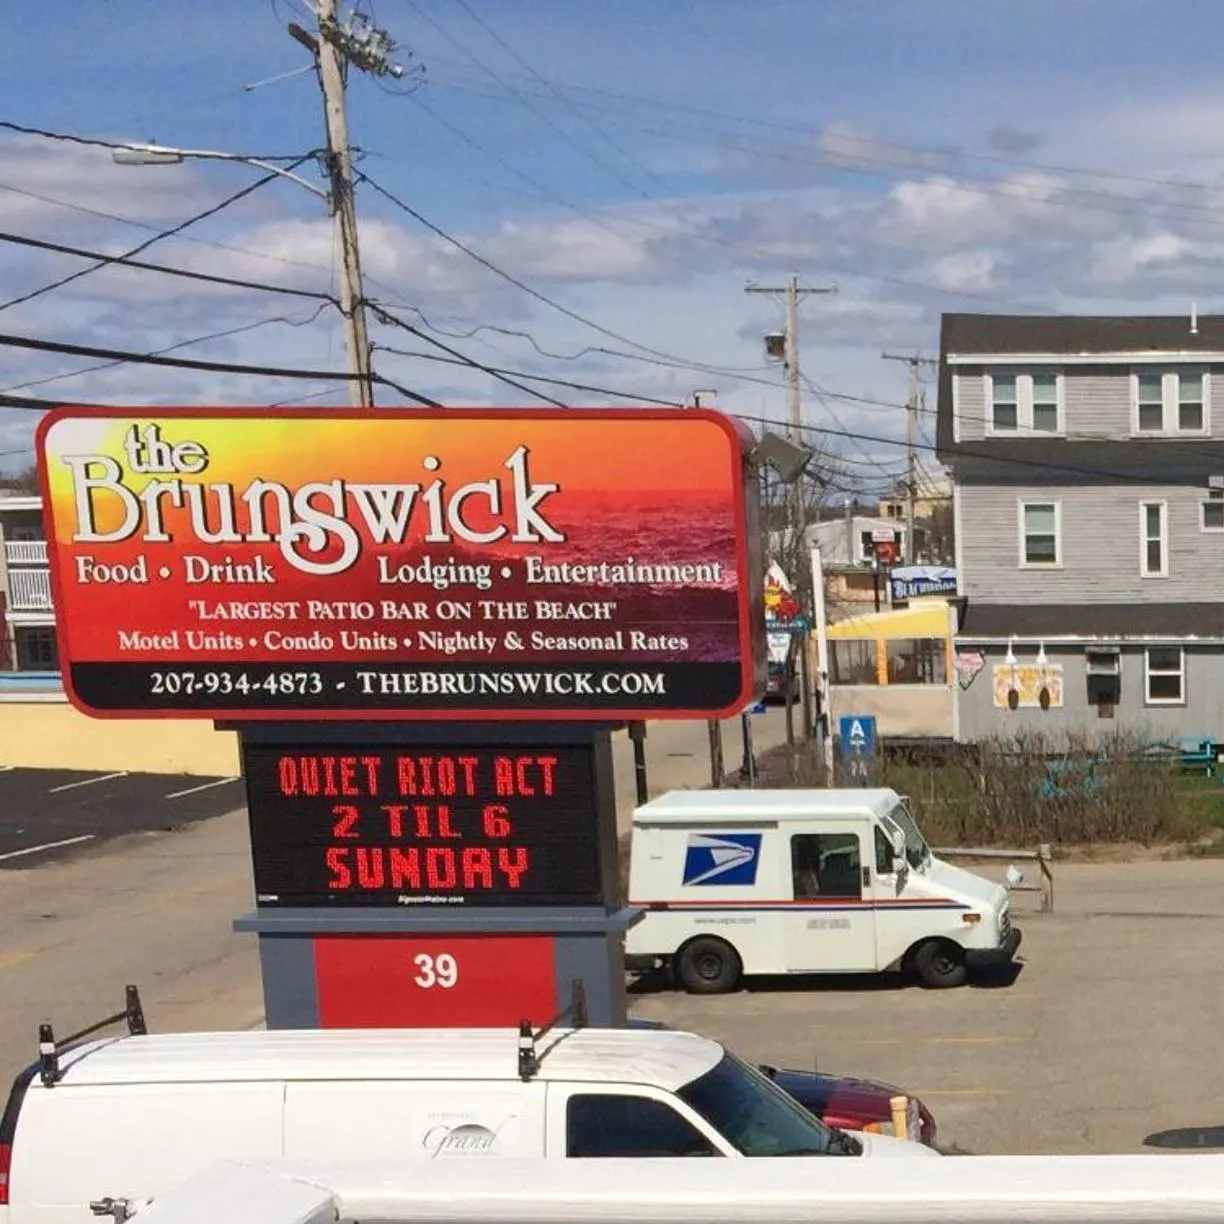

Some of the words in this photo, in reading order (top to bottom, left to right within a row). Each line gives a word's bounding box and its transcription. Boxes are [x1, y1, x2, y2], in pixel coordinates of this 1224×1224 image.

[124, 423, 208, 474] the
[62, 445, 567, 576] Brunswick
[75, 555, 148, 583] Food
[183, 555, 275, 583] Drink
[378, 556, 493, 589] Lodging
[526, 555, 723, 583] Entertainment
[188, 600, 299, 620] "LARGEST
[307, 600, 374, 620] PATIO
[380, 600, 430, 620] BAR
[436, 600, 471, 620] ON
[478, 600, 529, 620] THE
[535, 601, 617, 620] BEACH"
[117, 630, 179, 650] Motel
[185, 630, 244, 650] Units
[263, 630, 334, 650] Condo
[340, 630, 398, 650] Units
[418, 630, 496, 655] Nightly
[503, 630, 525, 651] &
[531, 630, 624, 651] Seasonal
[629, 631, 689, 651] Rates
[150, 672, 323, 695] 207-934-4873
[356, 671, 667, 695] THEBRUNSWICK.COM
[278, 757, 381, 796] QUIET
[397, 757, 478, 796] RIOT
[494, 757, 557, 796] ACT
[332, 805, 360, 837] 2
[380, 805, 462, 837] TIL
[482, 805, 510, 837] 6
[325, 848, 529, 889] SUNDAY
[413, 953, 458, 989] 39
